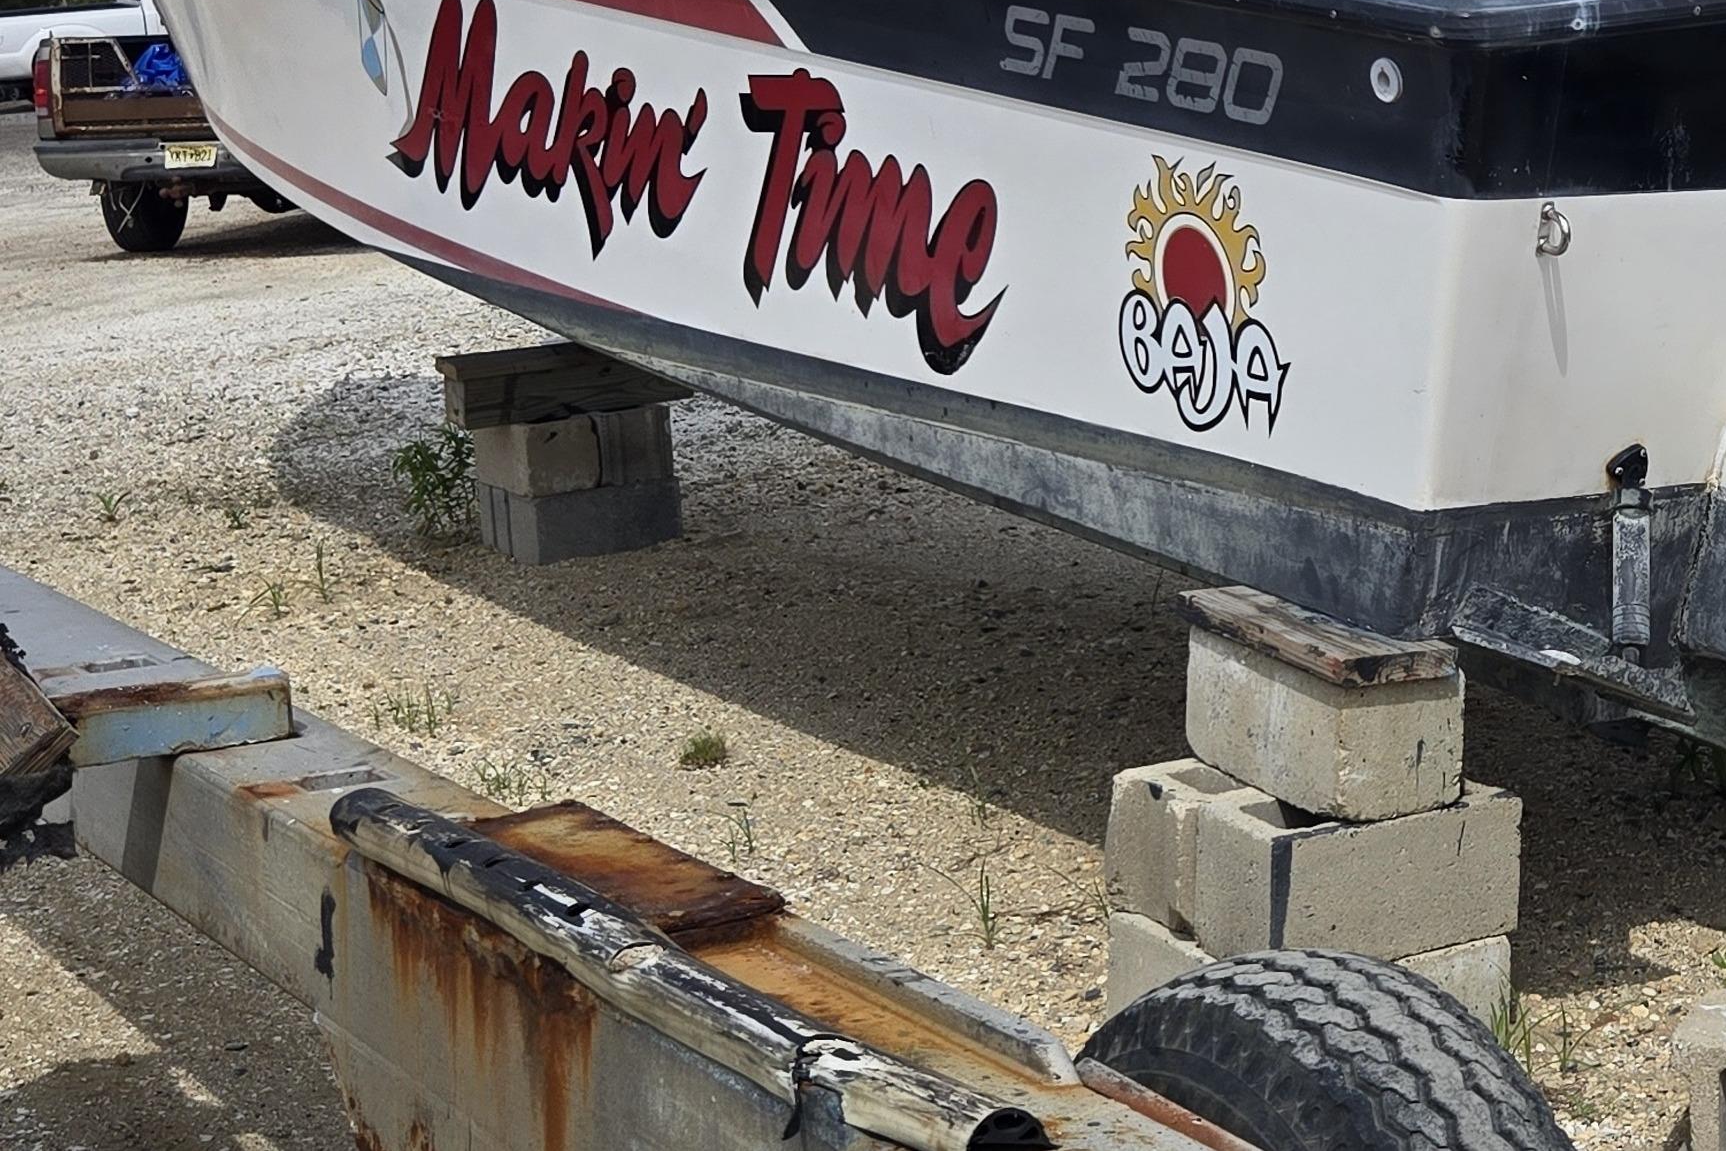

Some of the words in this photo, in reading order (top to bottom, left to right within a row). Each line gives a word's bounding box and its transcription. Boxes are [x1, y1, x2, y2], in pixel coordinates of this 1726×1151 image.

[1000, 4, 1096, 80] SF
[1114, 25, 1285, 126] 280
[739, 67, 1008, 376] Time
[1118, 287, 1292, 438] BAJA
